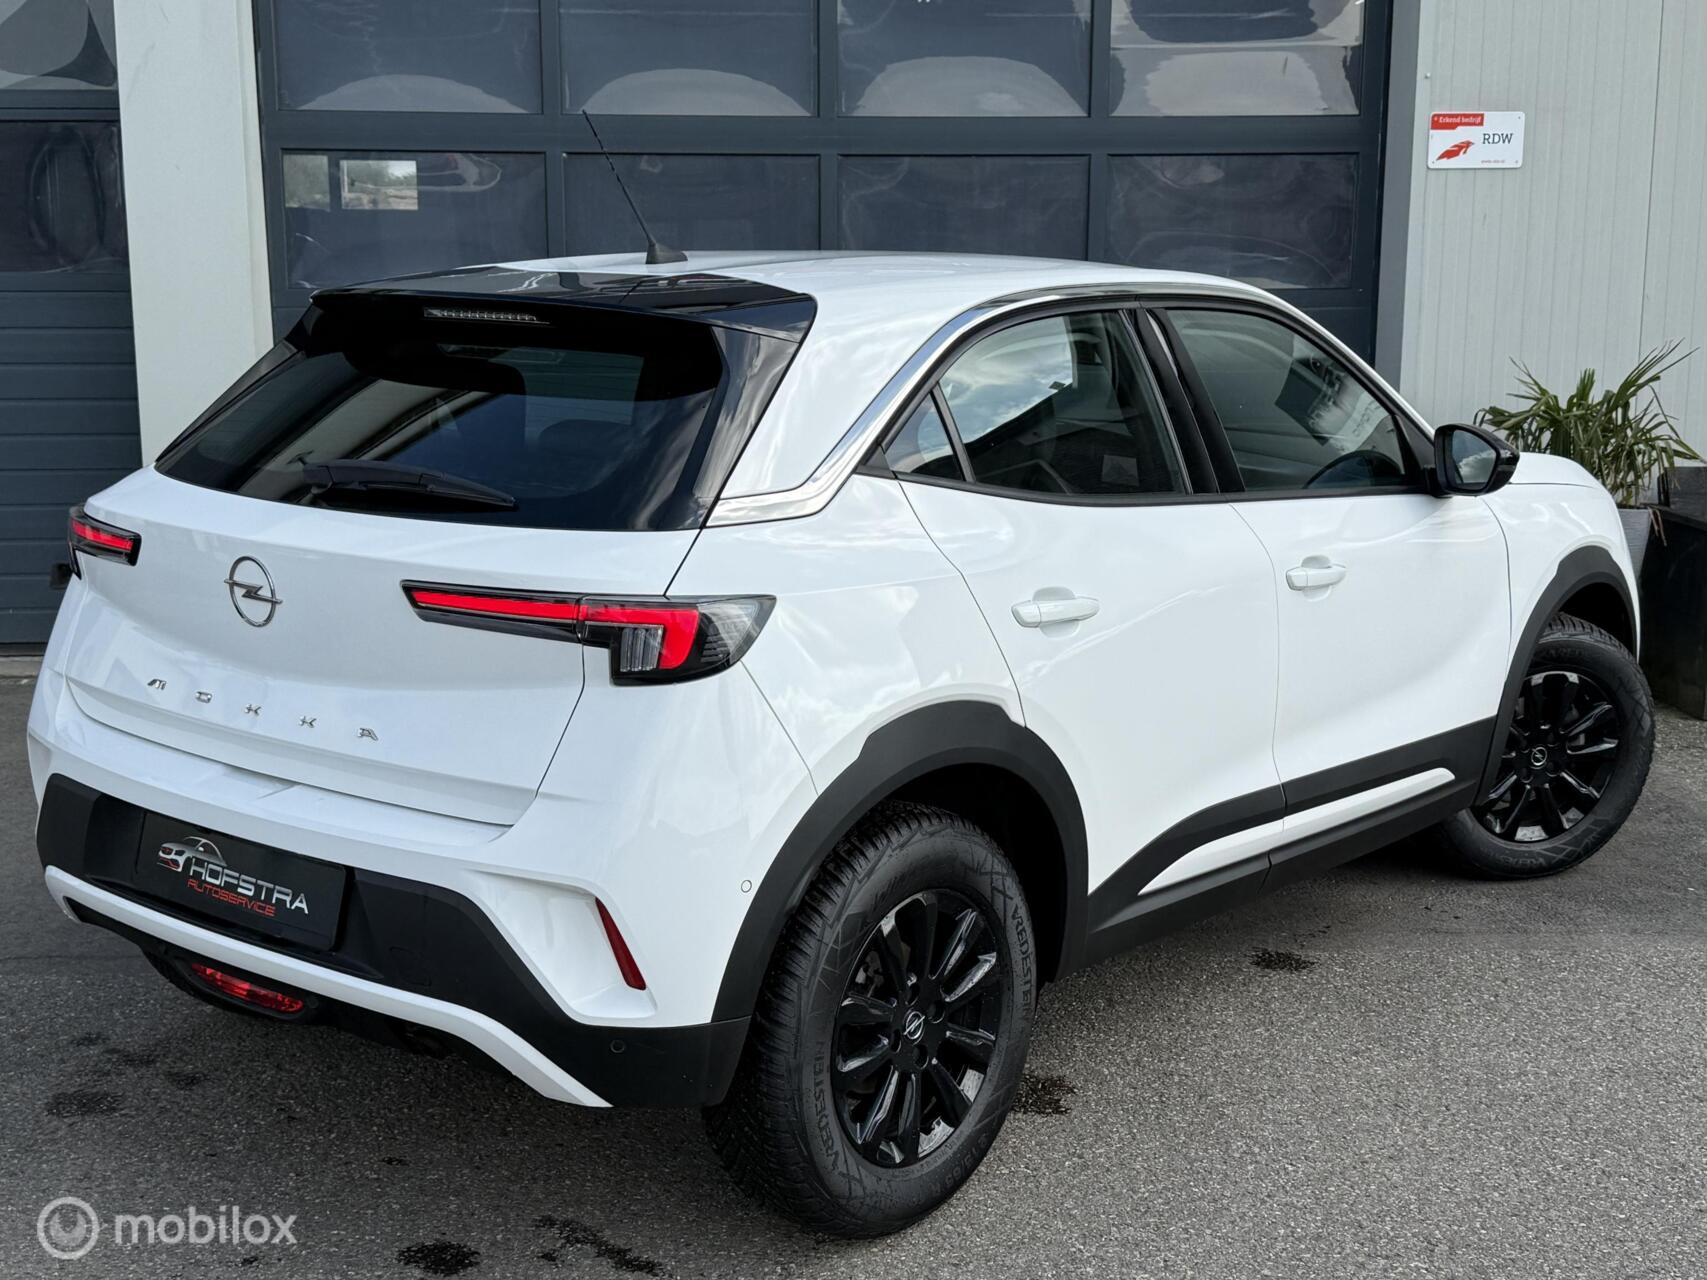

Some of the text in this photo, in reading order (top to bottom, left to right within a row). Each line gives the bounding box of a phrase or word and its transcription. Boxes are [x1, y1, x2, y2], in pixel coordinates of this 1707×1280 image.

[1439, 115, 1482, 124] Erkend bedrijf
[1482, 133, 1513, 144] RDW
[147, 678, 379, 741] MOKKA
[187, 879, 278, 917] AUTOSERVICE
[189, 857, 309, 915] HOFSTRA
